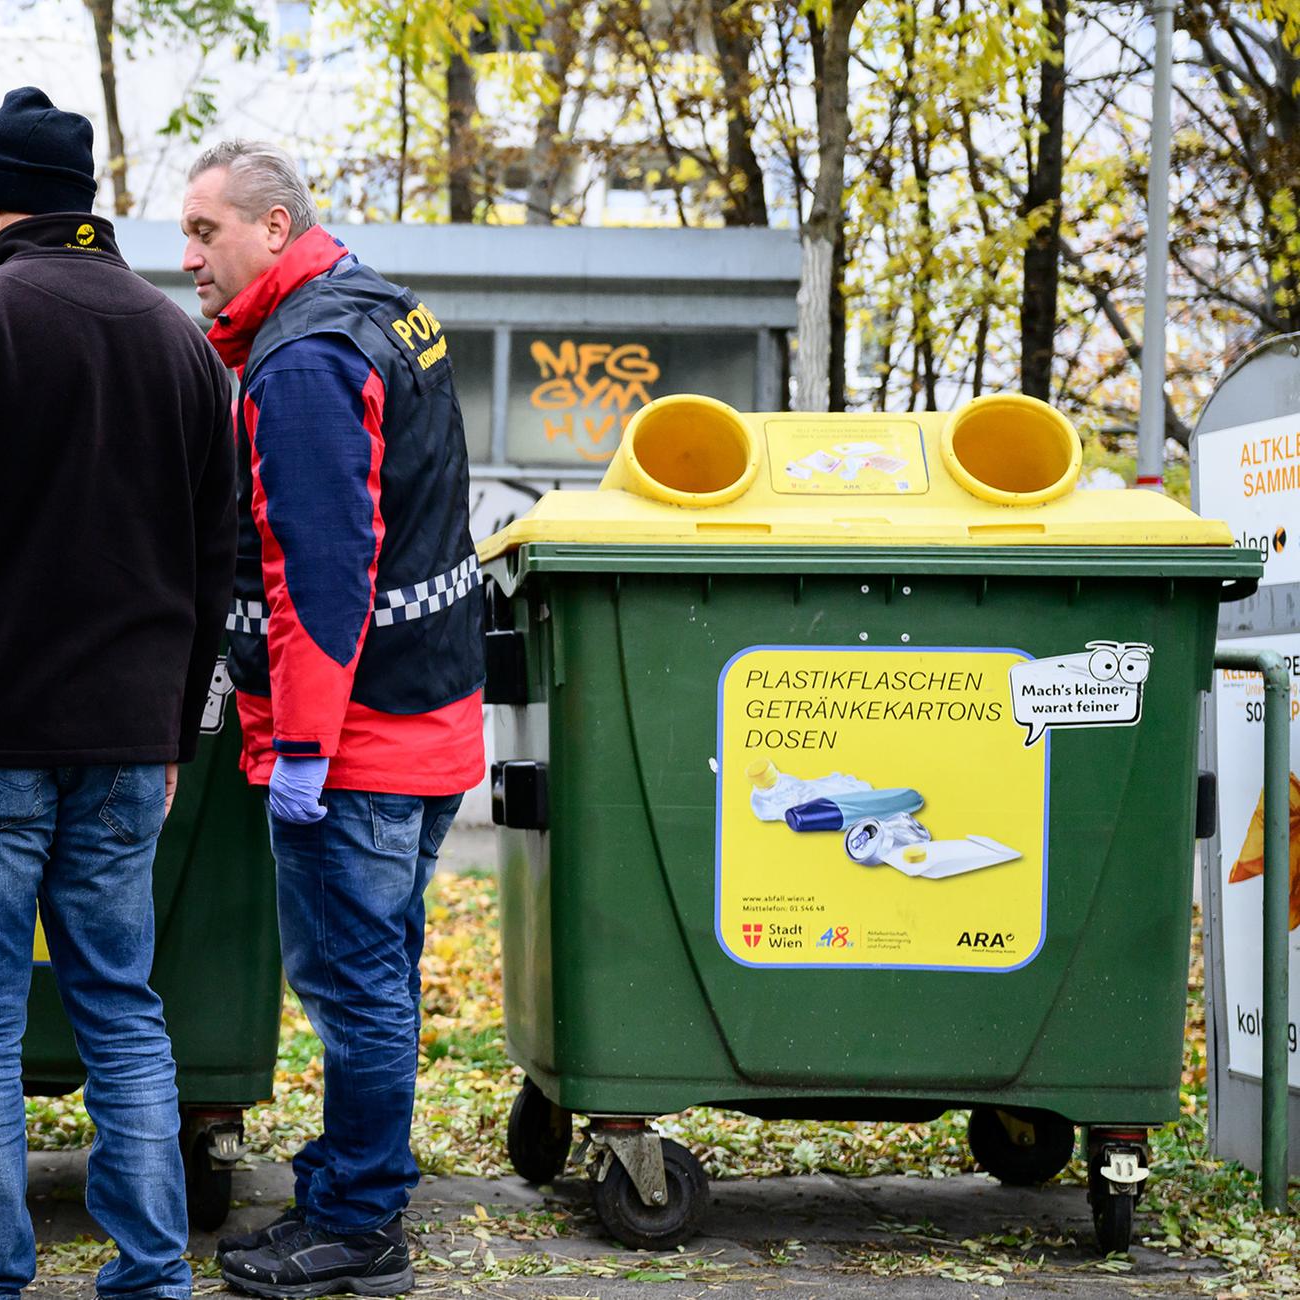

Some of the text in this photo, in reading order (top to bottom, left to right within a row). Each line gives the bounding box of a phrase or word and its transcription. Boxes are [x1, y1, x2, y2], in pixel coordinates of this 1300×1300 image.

[529, 339, 660, 384] MFG
[745, 669, 983, 692] PLASTIKFLASCHEN
[1021, 682, 1130, 697] Mach's kleiner,
[745, 695, 1002, 722] GETRÄNKEKARTONS
[1031, 699, 1120, 714] warat feiner
[744, 729, 838, 750] DOSEN
[768, 923, 803, 936] Stadt
[768, 937, 803, 949] Wien
[956, 931, 1005, 948] ARA
